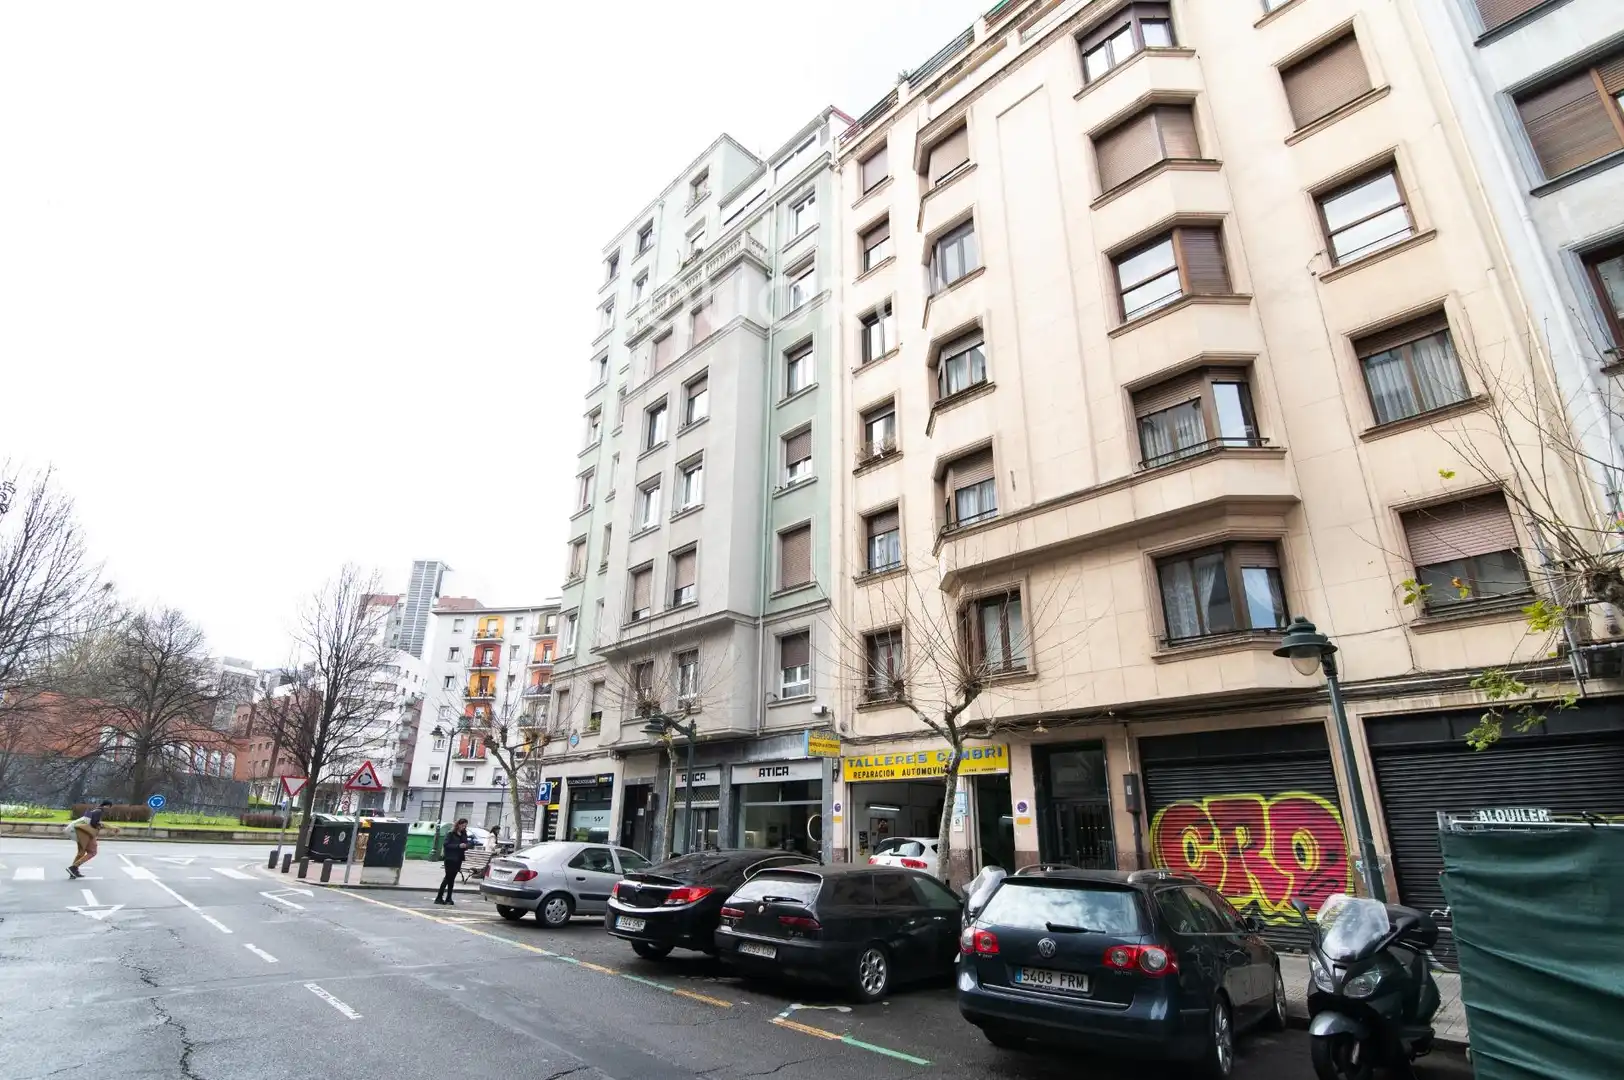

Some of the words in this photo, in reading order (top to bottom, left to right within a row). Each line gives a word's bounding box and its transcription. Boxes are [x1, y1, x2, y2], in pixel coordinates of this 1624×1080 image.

[847, 752, 928, 768] TALLERES
[681, 772, 706, 783] AICA
[758, 765, 789, 778] ATICA
[853, 769, 895, 779] REPARACION
[1478, 807, 1551, 823] ALQUILER
[1022, 968, 1053, 985] 5403
[1060, 972, 1085, 989] FRM
